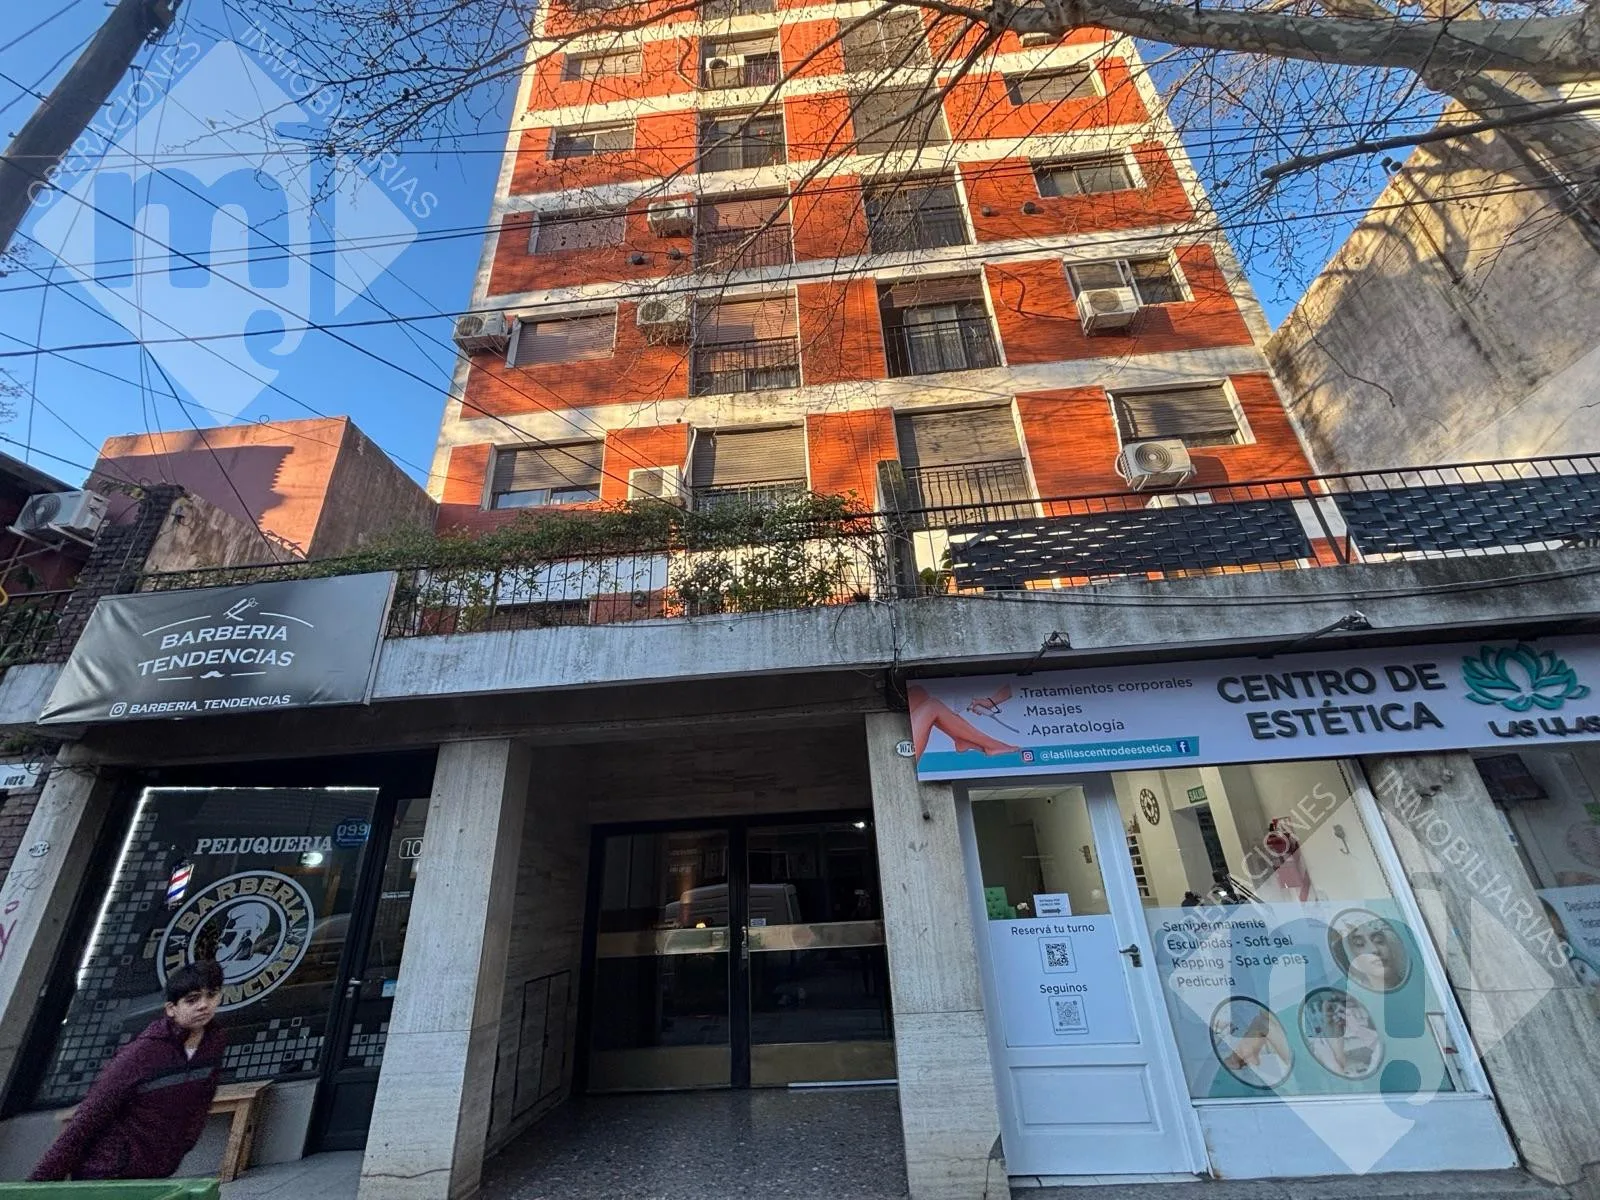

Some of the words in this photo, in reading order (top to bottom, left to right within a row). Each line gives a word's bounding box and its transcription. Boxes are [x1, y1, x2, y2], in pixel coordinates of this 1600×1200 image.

[160, 624, 288, 650] BARBERIA
[137, 648, 295, 676] TENDENCIAS
[1118, 676, 1193, 697] corporales
[1216, 667, 1376, 703] CENTRO
[1384, 662, 1447, 692] DE
[129, 694, 291, 715] BARBERIA_TENDENCIAS
[1246, 700, 1444, 740] ESTÉTICA
[1488, 719, 1538, 738] LAS
[1039, 743, 1172, 761] @laslilascentrodeestetica
[194, 835, 333, 856] PELUQUERIA
[175, 877, 306, 930] BARBERIA
[1011, 923, 1052, 936] Reservá
[1054, 924, 1066, 934] tu
[1067, 923, 1095, 934] turno
[1162, 919, 1266, 935] Semipermanente
[1167, 938, 1233, 951] Esculpidas
[1244, 934, 1271, 948] Soft
[1274, 934, 1293, 949] gel
[1172, 956, 1224, 972] Kapping
[1235, 955, 1260, 970] Spa
[1263, 953, 1279, 967] de
[1282, 952, 1309, 968] pies
[1039, 983, 1088, 996] Seguinos
